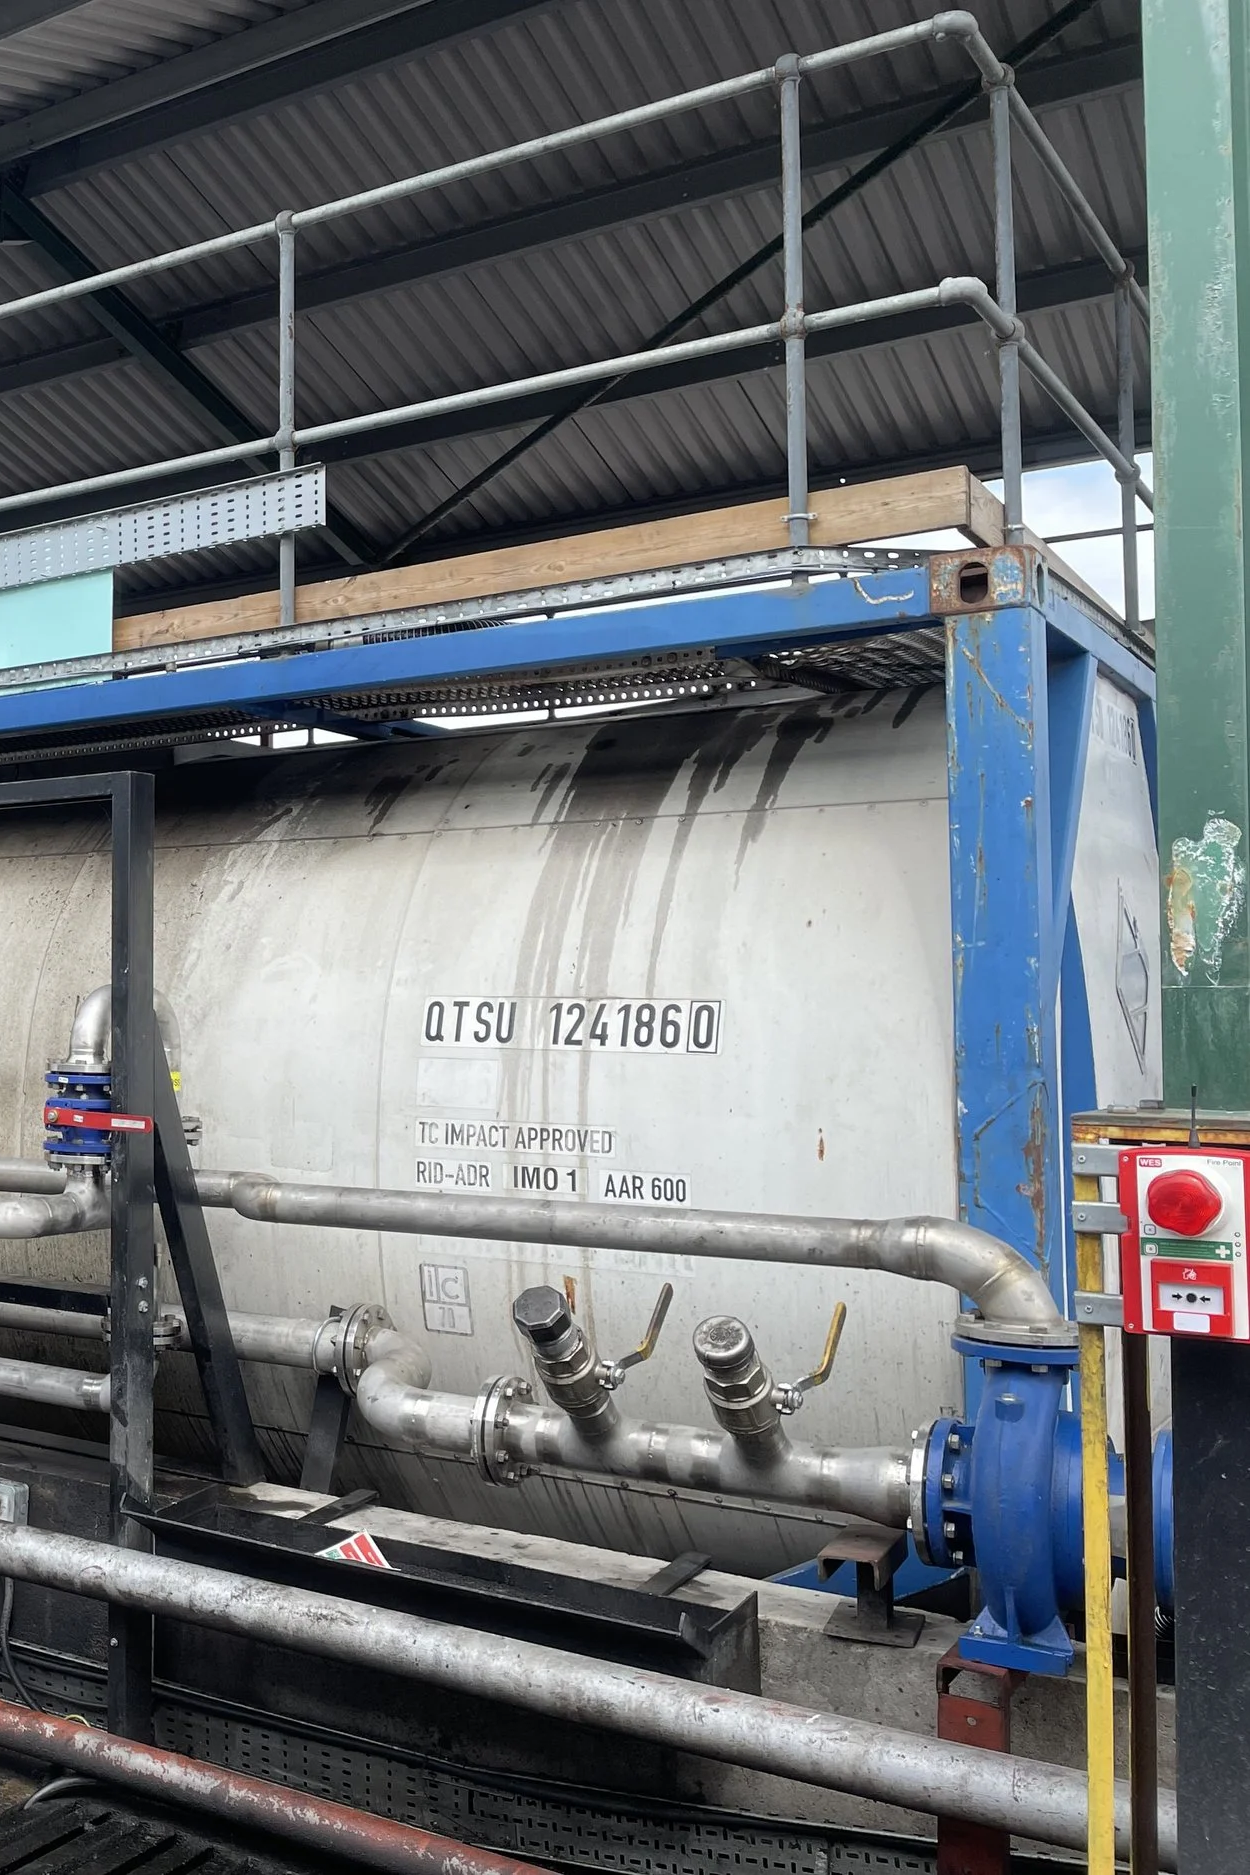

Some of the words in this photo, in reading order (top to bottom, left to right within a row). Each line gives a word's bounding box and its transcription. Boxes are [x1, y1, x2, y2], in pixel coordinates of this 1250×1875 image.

[425, 1001, 518, 1044] QTSU
[549, 1002, 716, 1050] 1241860
[418, 1121, 439, 1145] TC
[445, 1123, 510, 1149] IMPACT
[514, 1126, 613, 1154] APPROVED
[416, 1160, 491, 1188] RID-ADR
[513, 1165, 559, 1192] IMO
[566, 1169, 577, 1192] 1
[604, 1173, 645, 1200] AAR
[651, 1177, 687, 1203] 600
